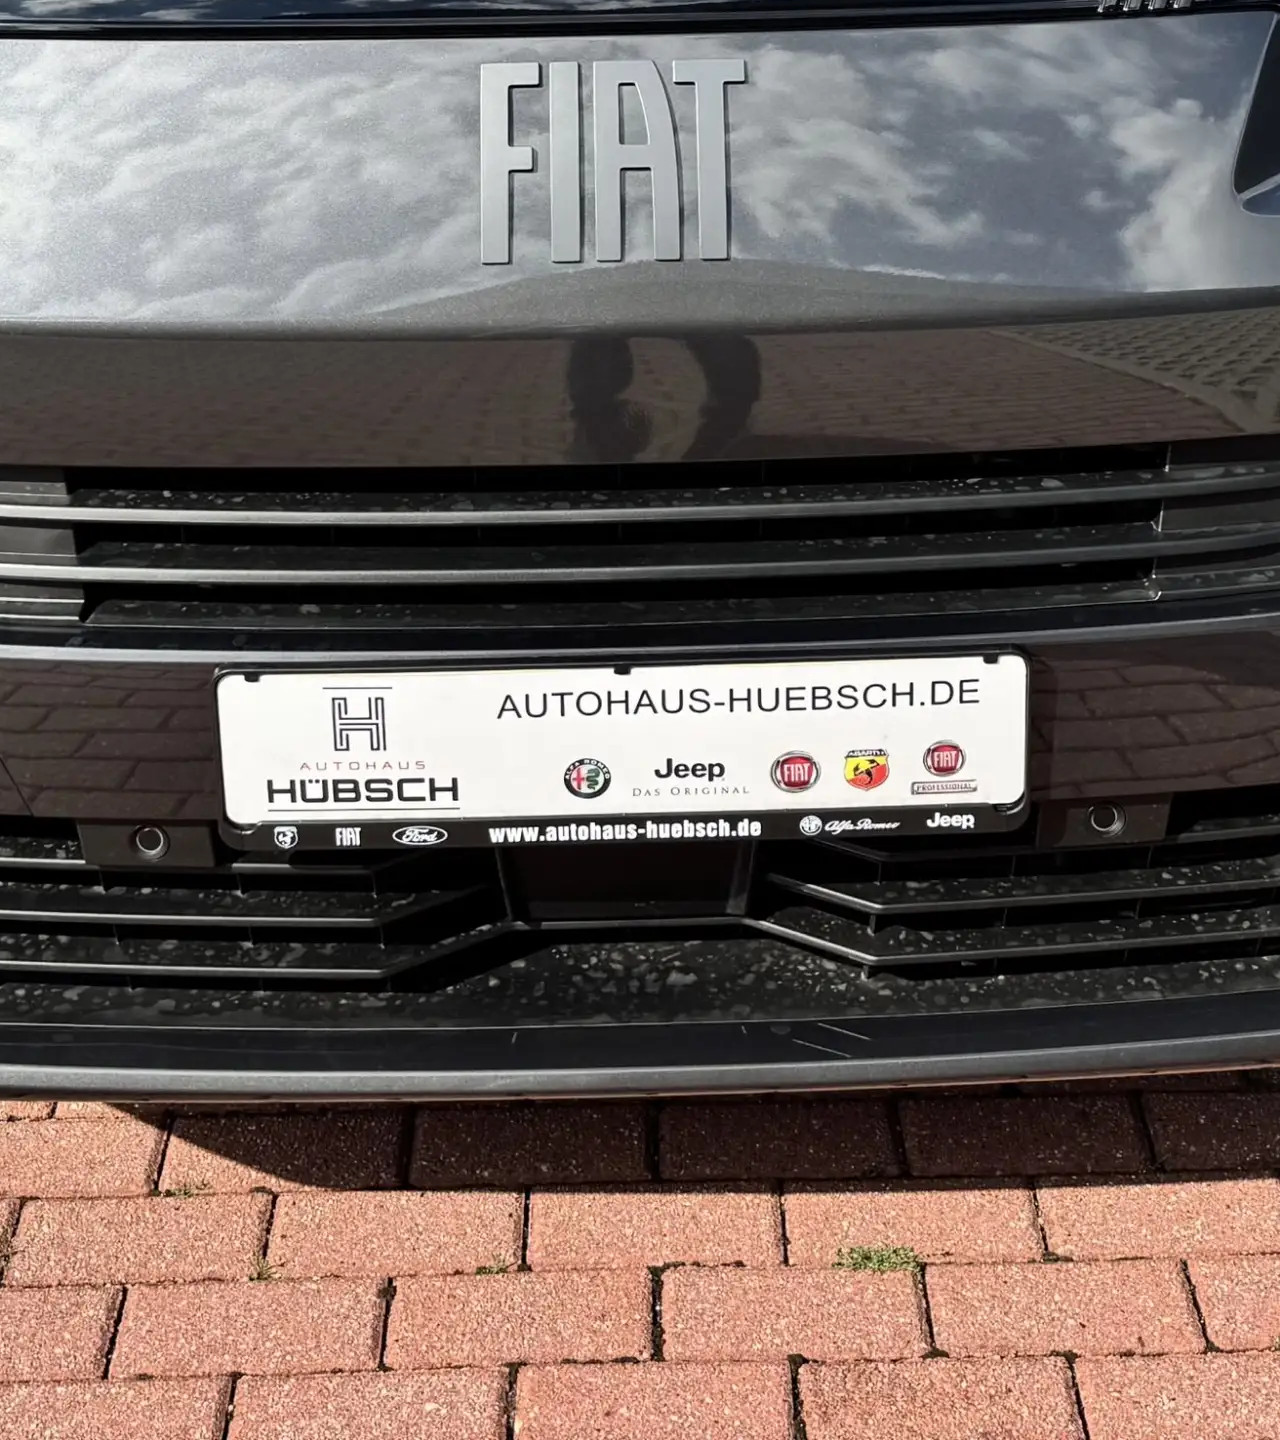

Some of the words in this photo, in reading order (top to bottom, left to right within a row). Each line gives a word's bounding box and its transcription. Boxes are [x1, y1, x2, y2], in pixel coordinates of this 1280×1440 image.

[480, 59, 750, 265] FIAT
[497, 679, 980, 719] AUTOHAUS-HUEBSCH.DE
[299, 760, 426, 771] AUTOHAUS
[933, 751, 957, 768] FIAT
[653, 758, 726, 782] Jeep
[783, 762, 811, 783] FIAT
[267, 777, 459, 803] HÜBSCH
[916, 783, 973, 792] PROFESSIONAL
[488, 819, 762, 843] www.autohaus-huebsch.de
[926, 812, 975, 830] Jeep
[335, 827, 361, 846] FIAT
[402, 827, 439, 843] Ford
